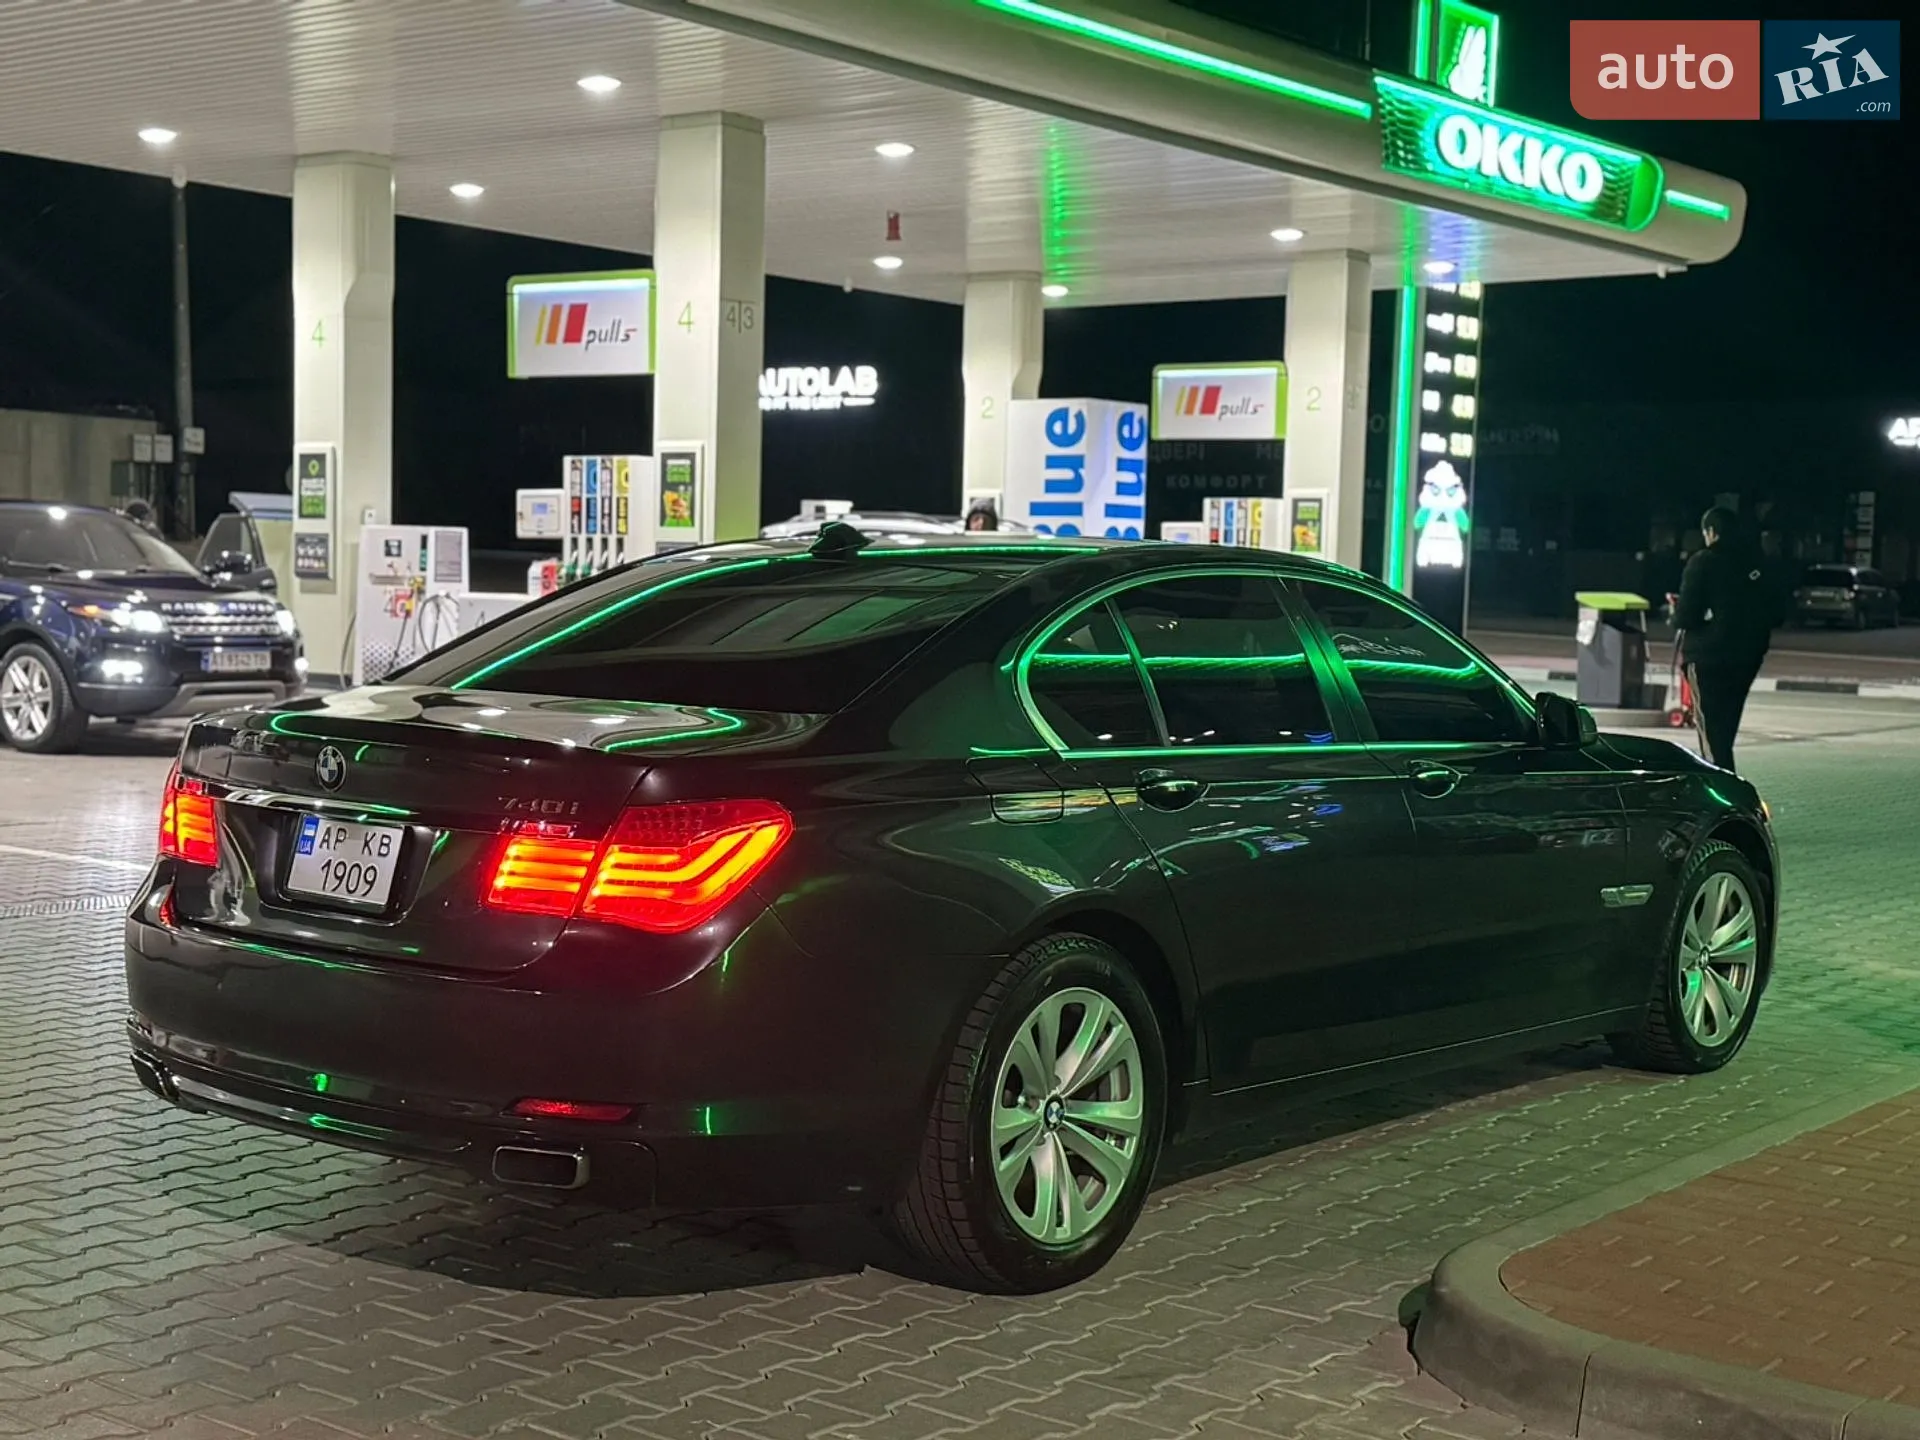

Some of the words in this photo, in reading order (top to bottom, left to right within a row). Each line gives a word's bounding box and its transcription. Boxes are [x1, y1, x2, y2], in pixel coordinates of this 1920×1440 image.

[1436, 115, 1604, 203] OKKO
[678, 301, 694, 333] 4
[310, 319, 325, 348] 4
[585, 318, 637, 354] pulls
[981, 397, 994, 419] 2
[1218, 397, 1264, 421] pulls
[1306, 386, 1321, 411] 2
[319, 826, 347, 850] AP
[361, 831, 392, 857] KB
[321, 858, 378, 897] 1909
